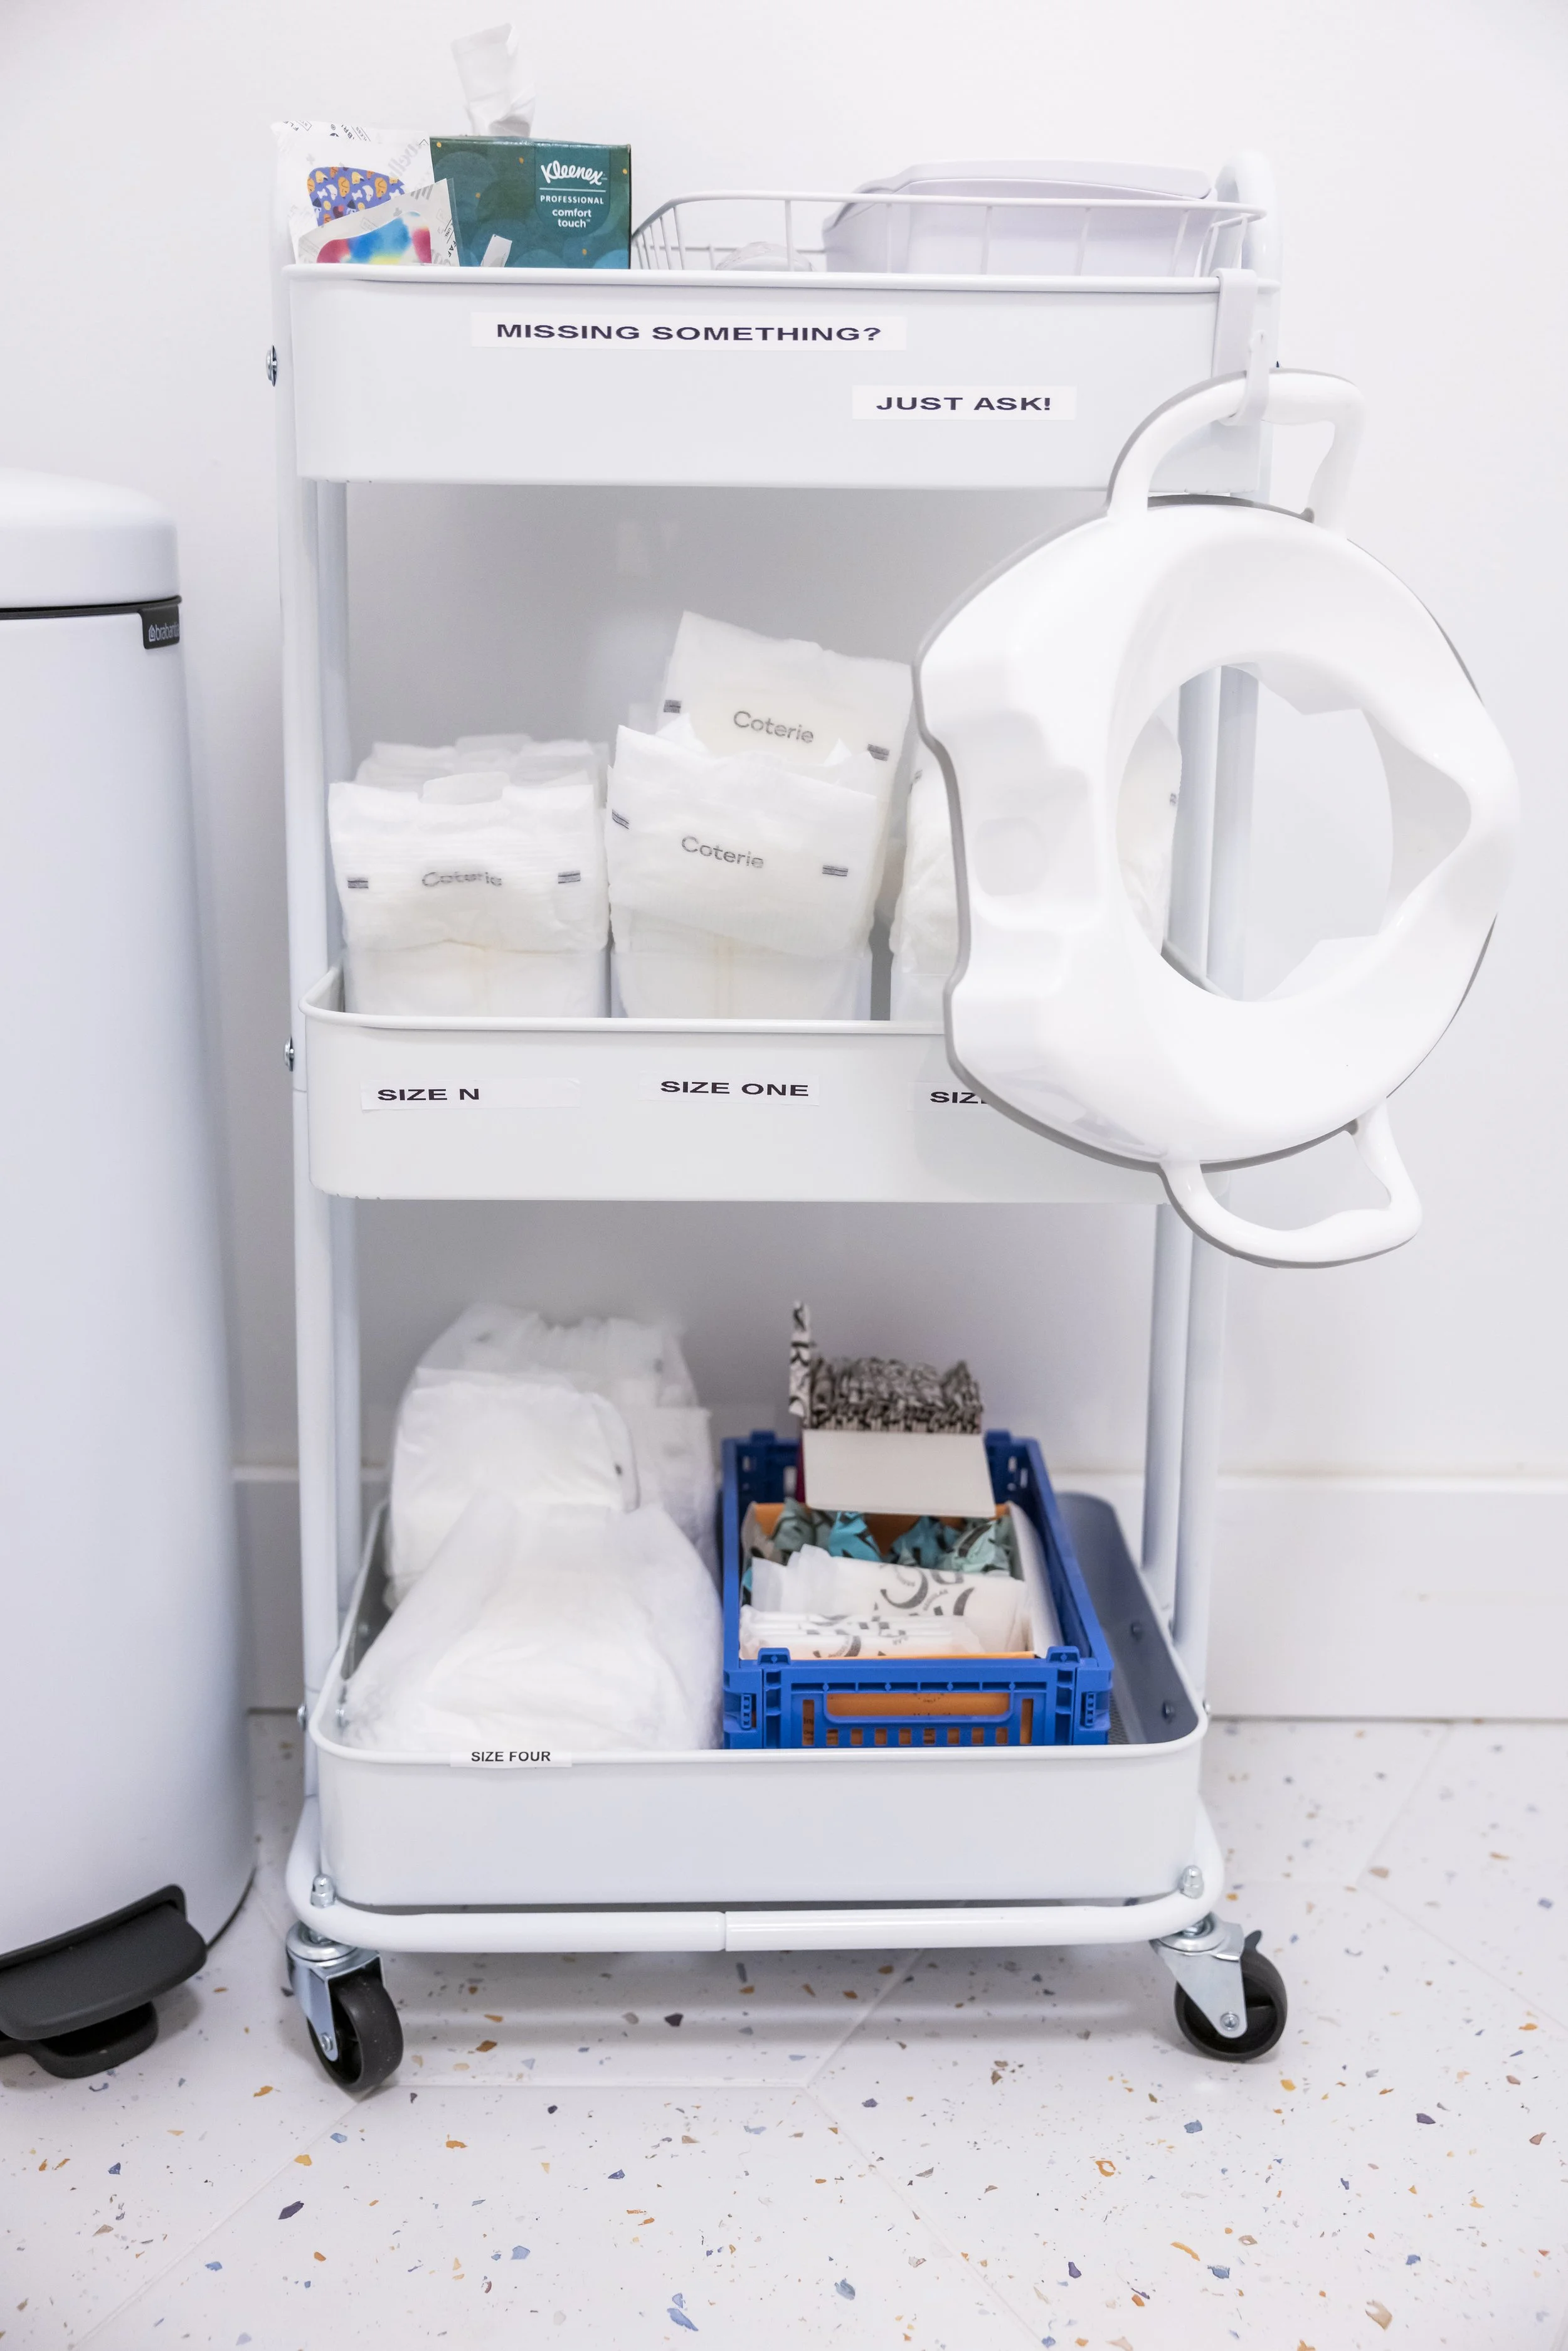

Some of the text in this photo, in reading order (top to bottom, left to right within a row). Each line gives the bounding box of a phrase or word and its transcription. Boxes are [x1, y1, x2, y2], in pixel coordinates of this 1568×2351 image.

[540, 160, 604, 186] Kleenex
[540, 194, 604, 205] PROFESSIONAL
[552, 208, 592, 218] comfort
[558, 218, 587, 228] touch
[497, 324, 882, 341] MISSING SOMETHING?
[876, 397, 1051, 411] JUST ASK!
[733, 710, 815, 744] Coterie
[681, 836, 764, 869] Coterie
[377, 1088, 480, 1101] SIZE N
[660, 1081, 810, 1096] SIZE ONE
[930, 1091, 989, 1104] SIZ
[471, 1751, 551, 1762] SIZE FOUR
